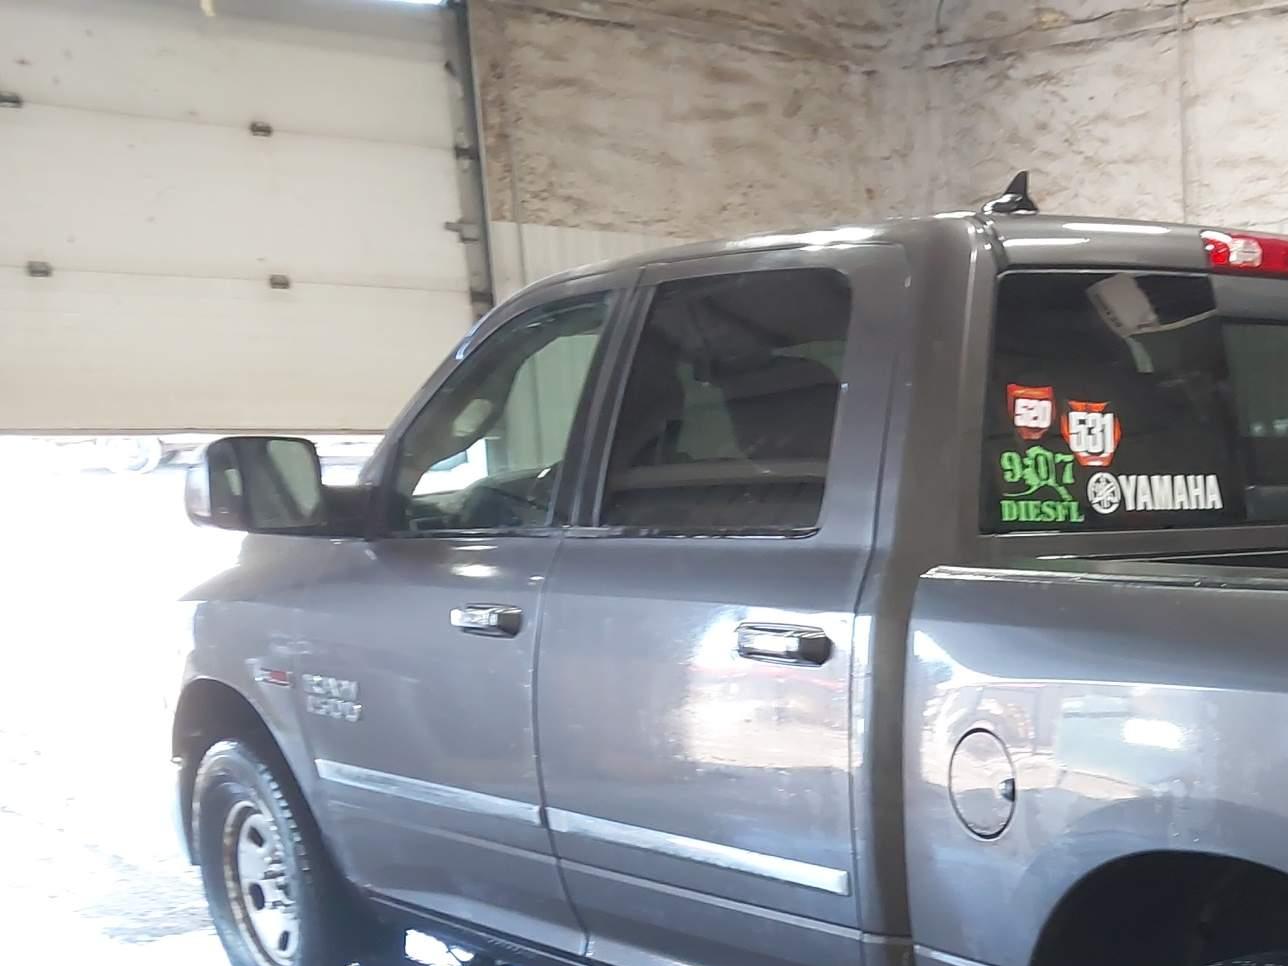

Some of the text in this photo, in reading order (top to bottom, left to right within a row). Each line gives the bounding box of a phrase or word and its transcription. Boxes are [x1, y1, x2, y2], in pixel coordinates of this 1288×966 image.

[1067, 410, 1115, 454] 531
[1000, 447, 1075, 485] 907
[1118, 474, 1223, 511] YAMAHA
